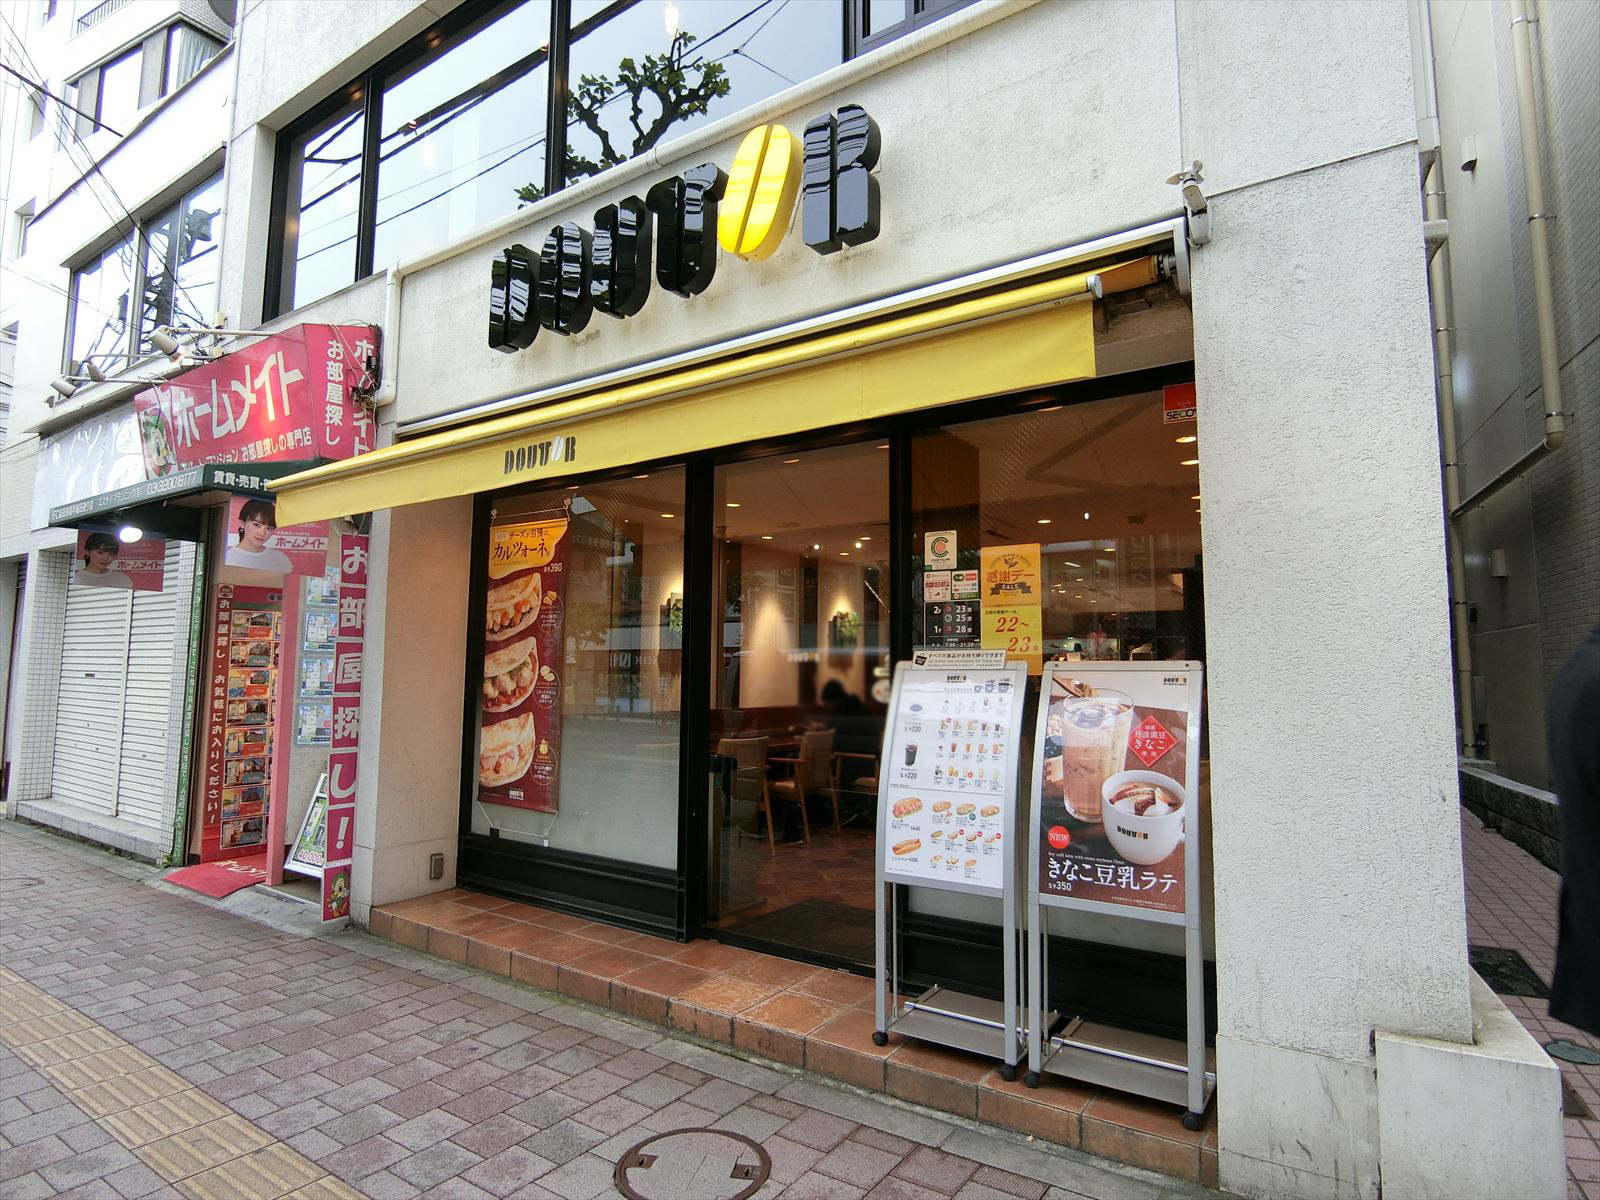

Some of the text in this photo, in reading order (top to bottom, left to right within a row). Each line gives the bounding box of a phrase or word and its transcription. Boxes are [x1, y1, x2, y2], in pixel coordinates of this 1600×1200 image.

[488, 104, 882, 354] DOUTOR
[172, 350, 304, 448] ホームメイト
[324, 339, 344, 446] お部屋探し
[240, 426, 312, 462] お部屋探しの専門店
[503, 435, 577, 475] DOUTOR
[275, 537, 325, 549] ホームメイト
[492, 537, 551, 561] カルツォーネ。
[117, 560, 162, 569] ホームメイト
[1135, 738, 1166, 749] きなこ
[1048, 832, 1070, 843] NEW
[1047, 857, 1178, 894] きなこ豆乳ラテ
